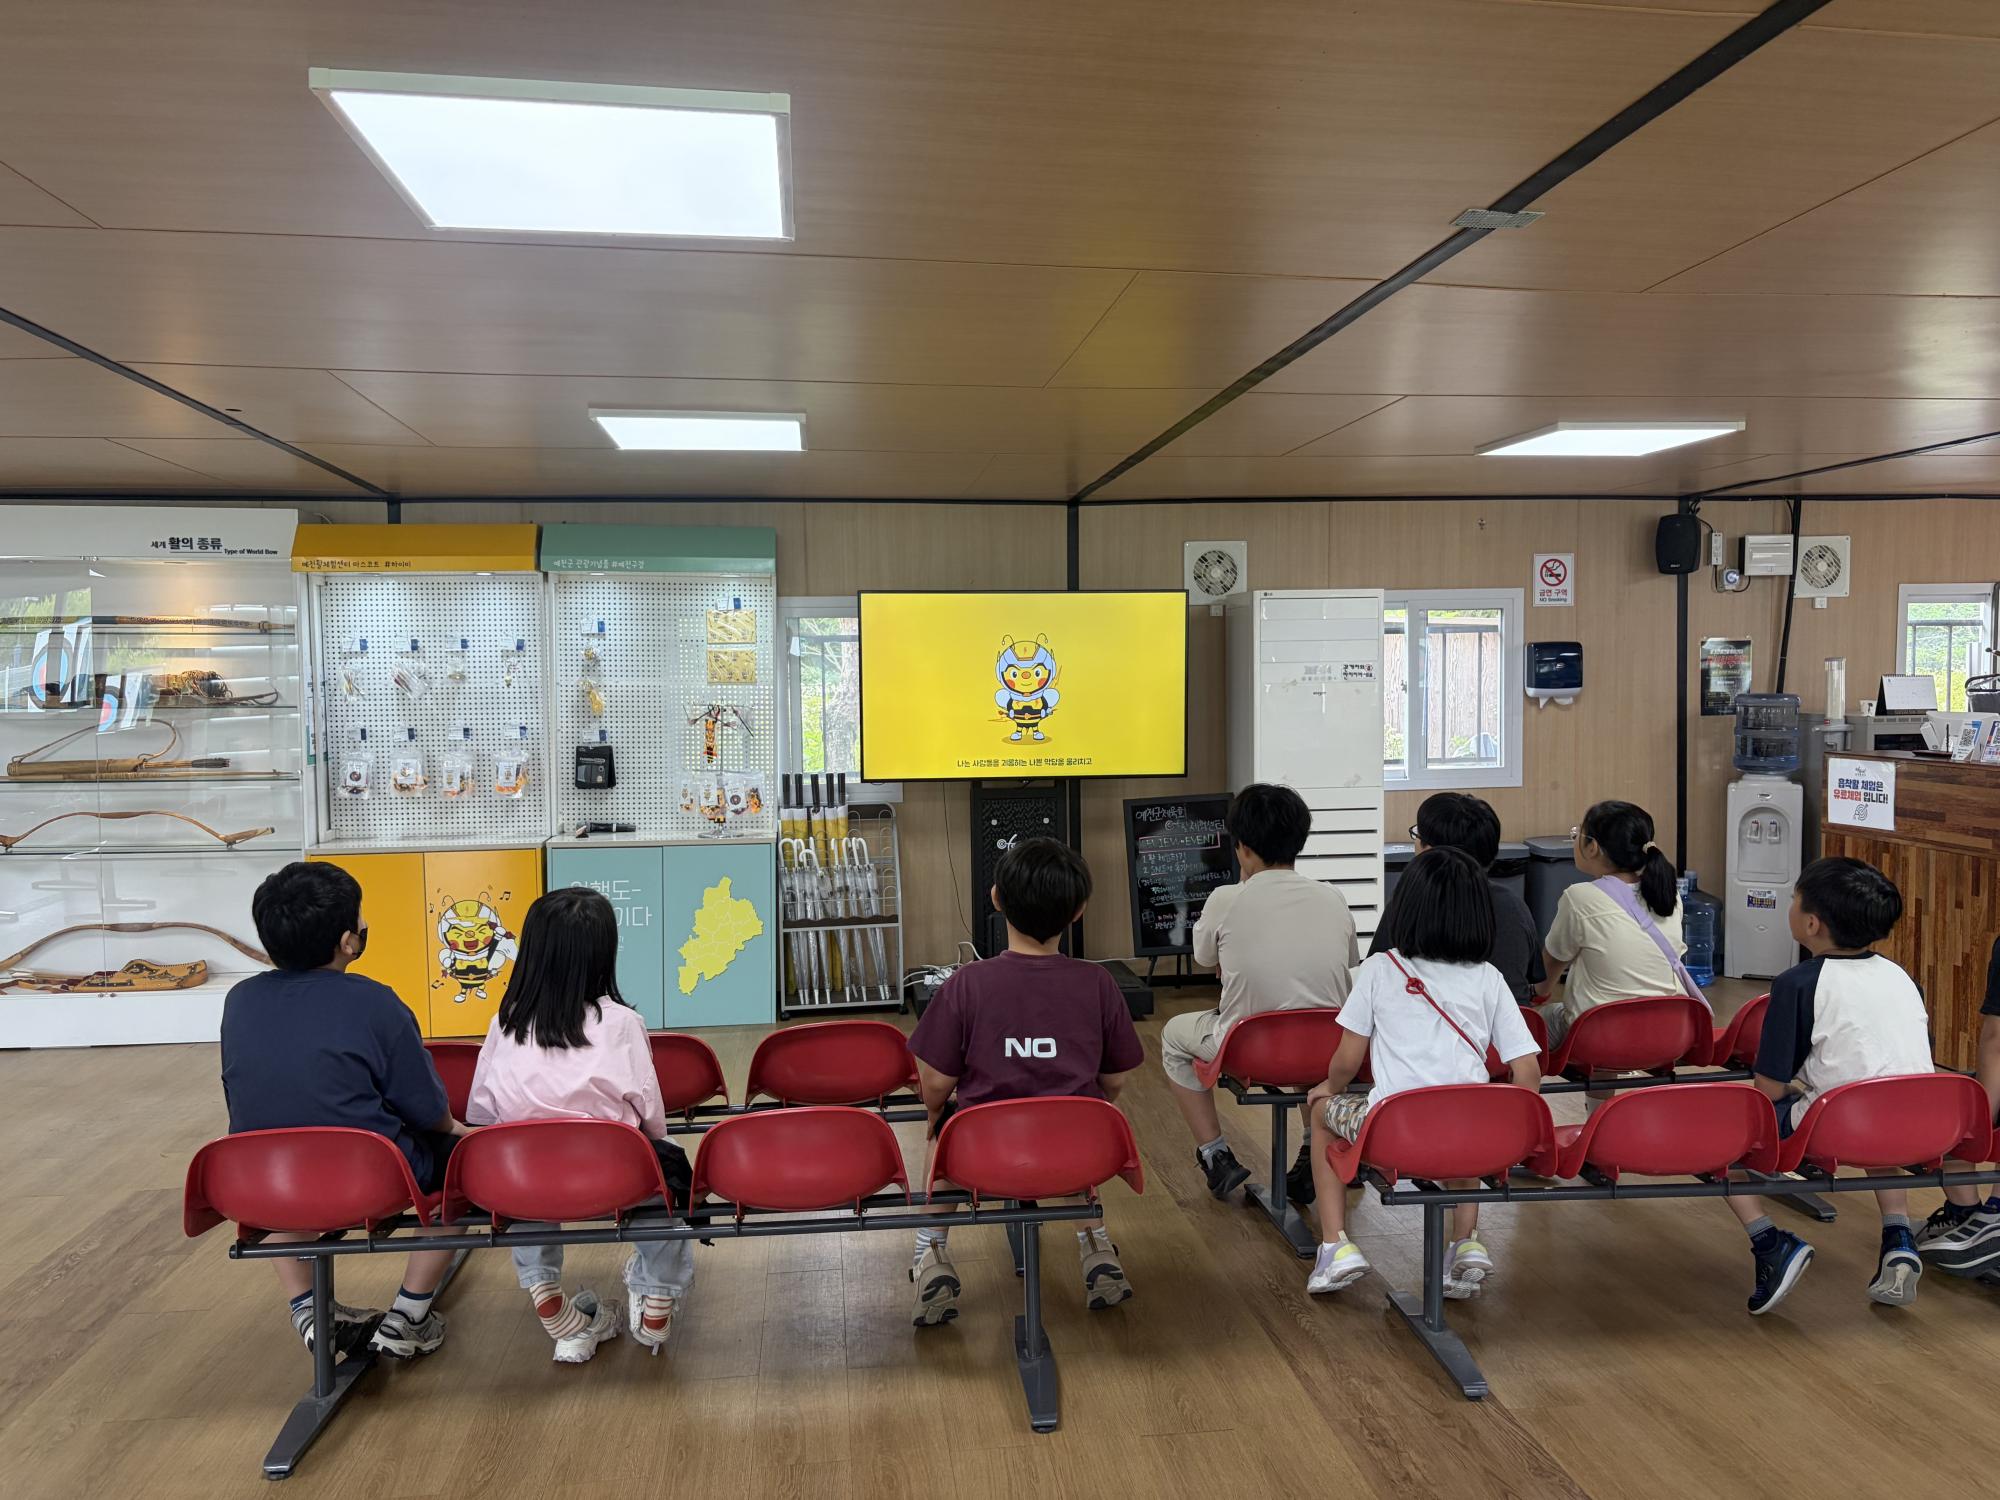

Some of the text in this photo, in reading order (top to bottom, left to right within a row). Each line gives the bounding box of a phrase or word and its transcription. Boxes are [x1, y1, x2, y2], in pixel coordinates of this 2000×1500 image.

[151, 536, 223, 550] 세계 활의 종류
[1539, 589, 1568, 597] 금연 구역
[957, 757, 1093, 768] 나는 사람들을 괴롭히는 나쁜 악당을 물리치고
[1838, 778, 1884, 792] 흡착활 체험은
[1833, 789, 1889, 804] 유료체험 입니다!
[1005, 1037, 1057, 1058] NO
